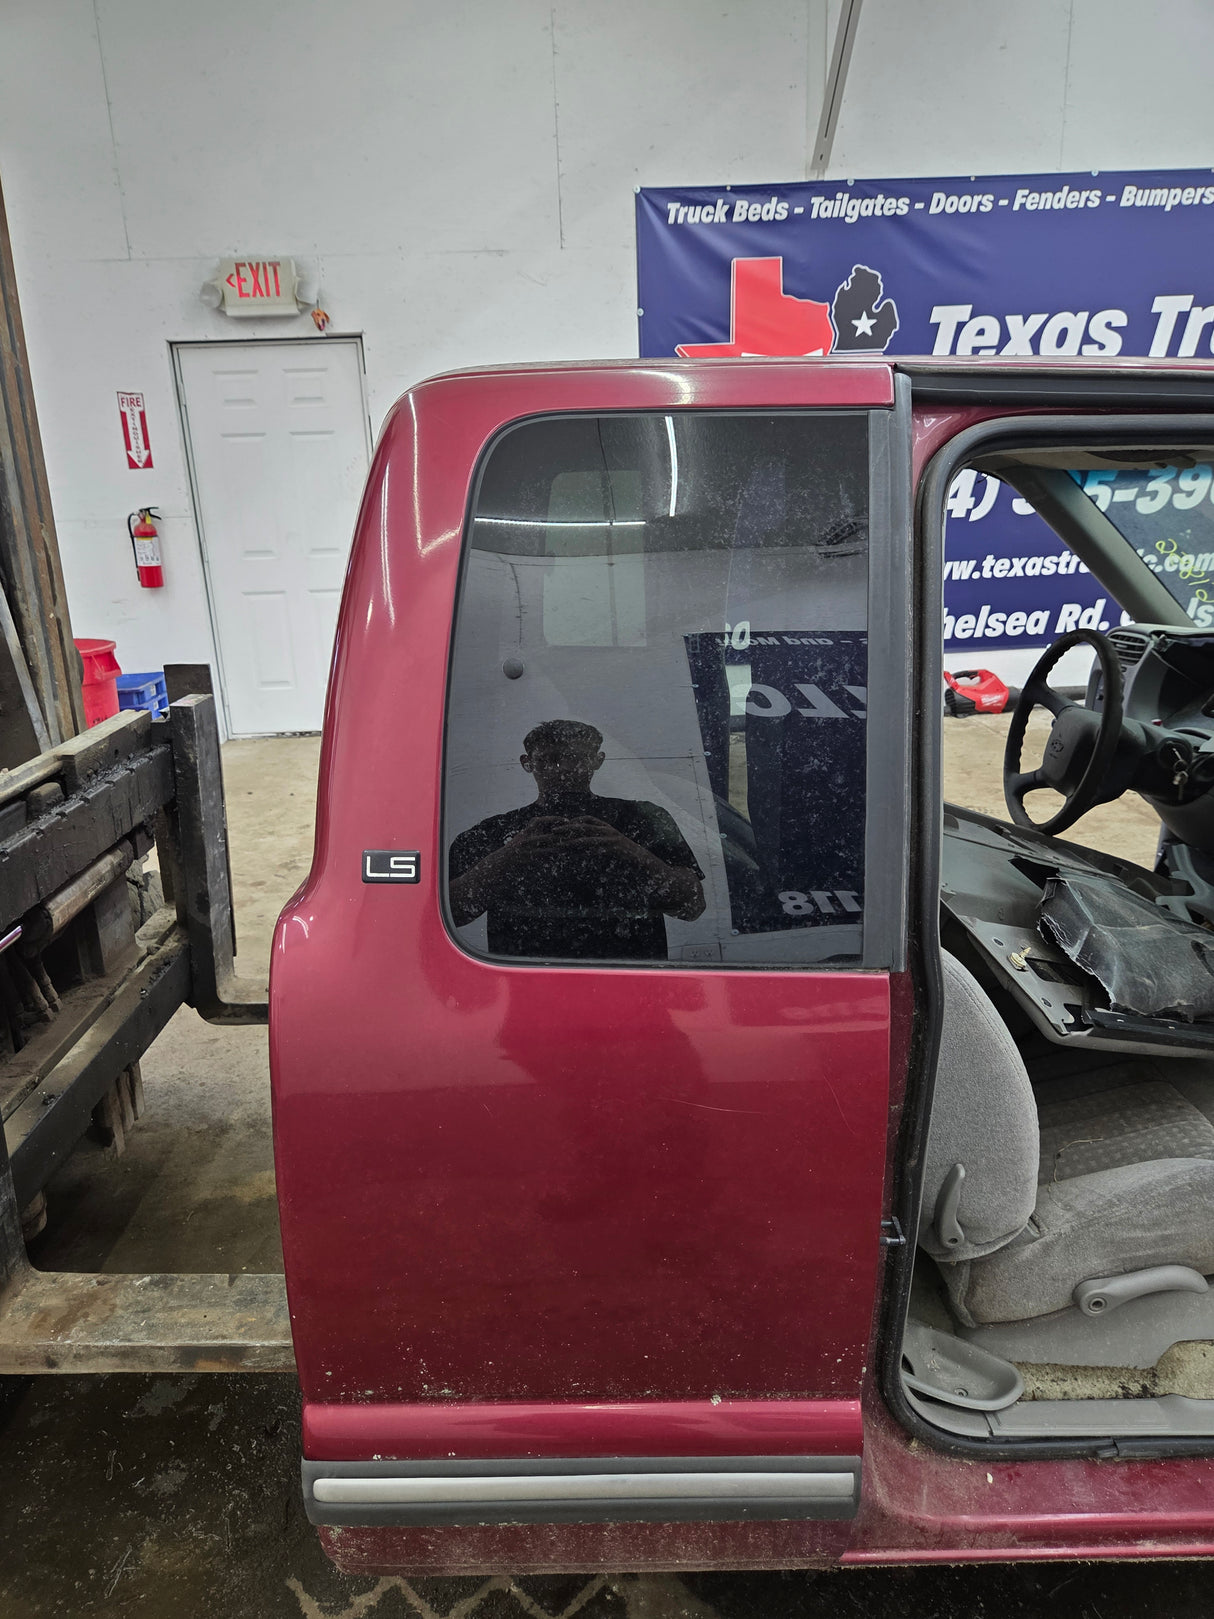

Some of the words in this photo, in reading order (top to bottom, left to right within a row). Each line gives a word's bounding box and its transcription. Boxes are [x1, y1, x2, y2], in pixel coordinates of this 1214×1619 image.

[667, 199, 729, 224] Truck
[732, 197, 790, 223] Beds
[810, 192, 911, 223] Tailgates
[929, 192, 994, 214] Doors
[1012, 186, 1102, 211] Fenders
[1119, 185, 1214, 211] Bumpers
[234, 261, 281, 298] EXIT
[929, 304, 1128, 356] Texas
[1148, 295, 1214, 357] Tr
[120, 397, 142, 408] FIRE
[1054, 598, 1110, 634] Rd.
[366, 855, 416, 878] LS
